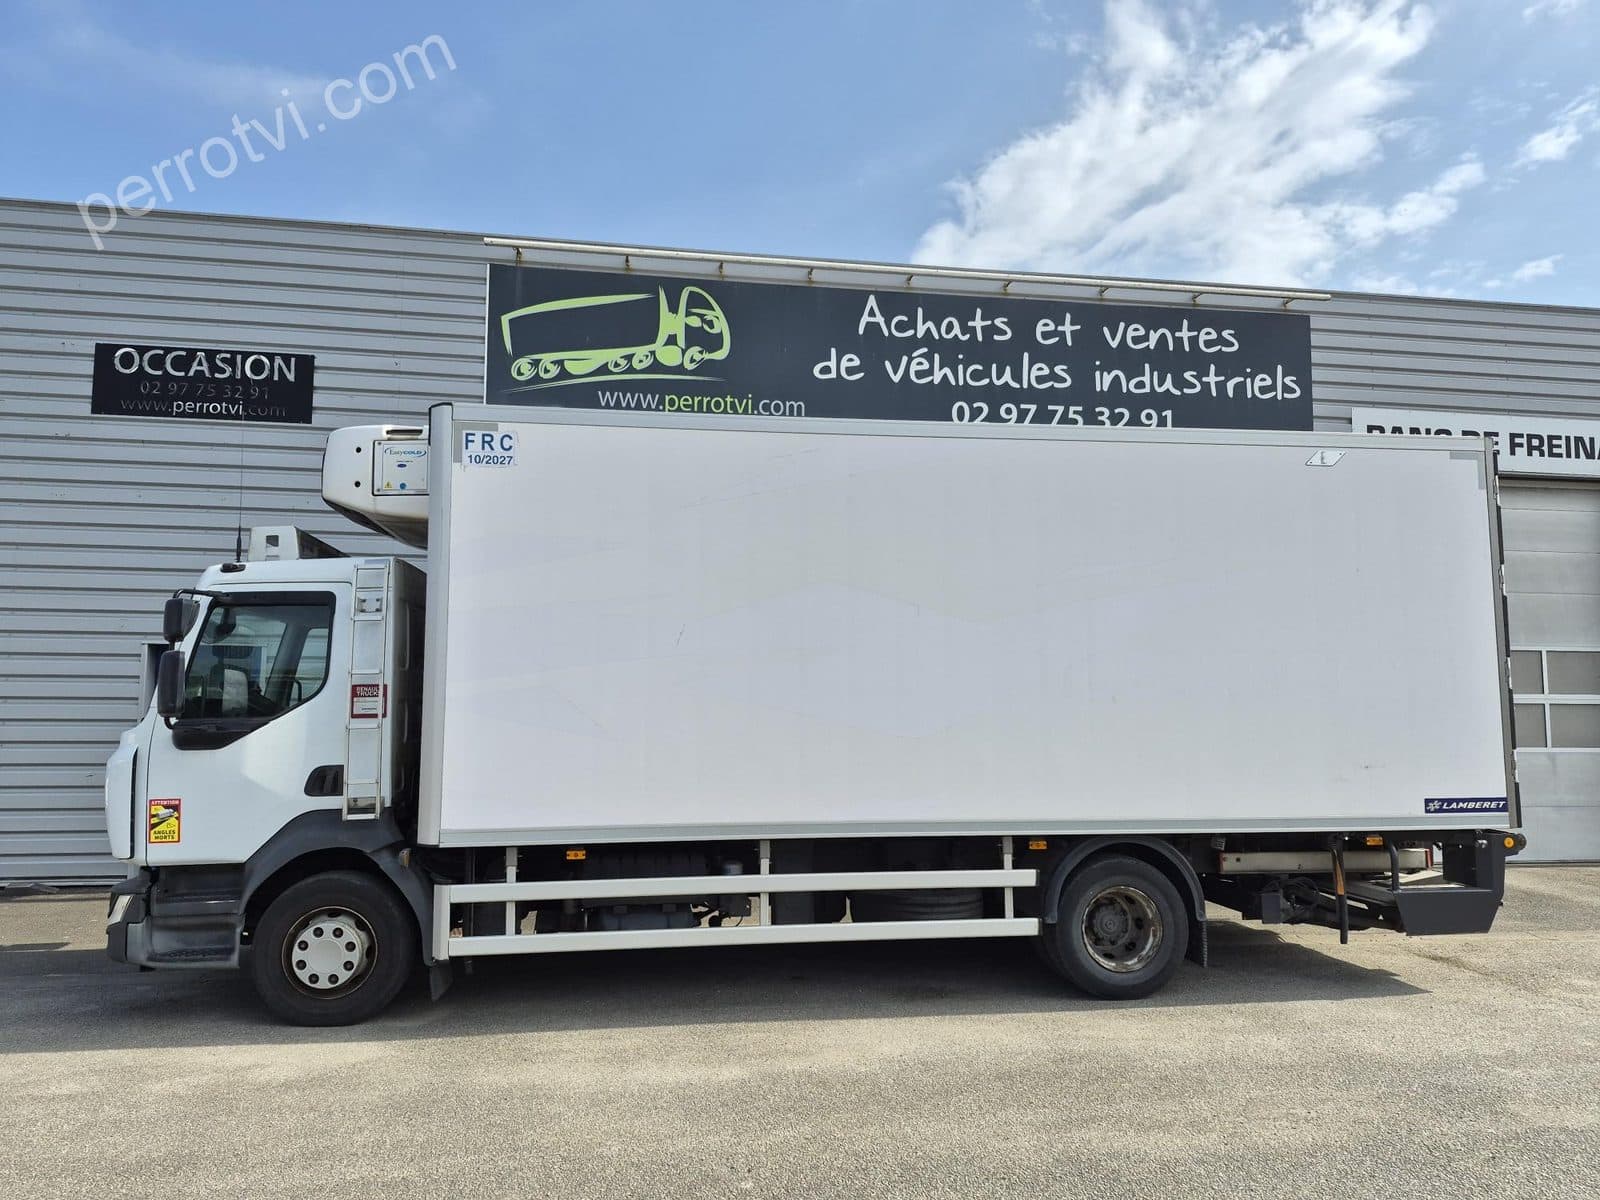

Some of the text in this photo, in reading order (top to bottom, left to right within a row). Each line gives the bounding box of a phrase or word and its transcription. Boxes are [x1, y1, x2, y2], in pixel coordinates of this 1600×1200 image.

[858, 294, 1240, 352] Achats et ventes
[113, 347, 296, 382] OCCASION
[813, 347, 1301, 400] de véhicules industriels
[140, 380, 269, 400] 02 97 75 32 91
[598, 390, 805, 417] www.perrotvi.com
[120, 399, 287, 418] www.perrotvi.com
[951, 401, 1173, 429] 02 97 75 32 91
[467, 454, 513, 465] 10/2027
[1509, 432, 1600, 460] FREIN
[1442, 801, 1506, 809] LAMBERET
